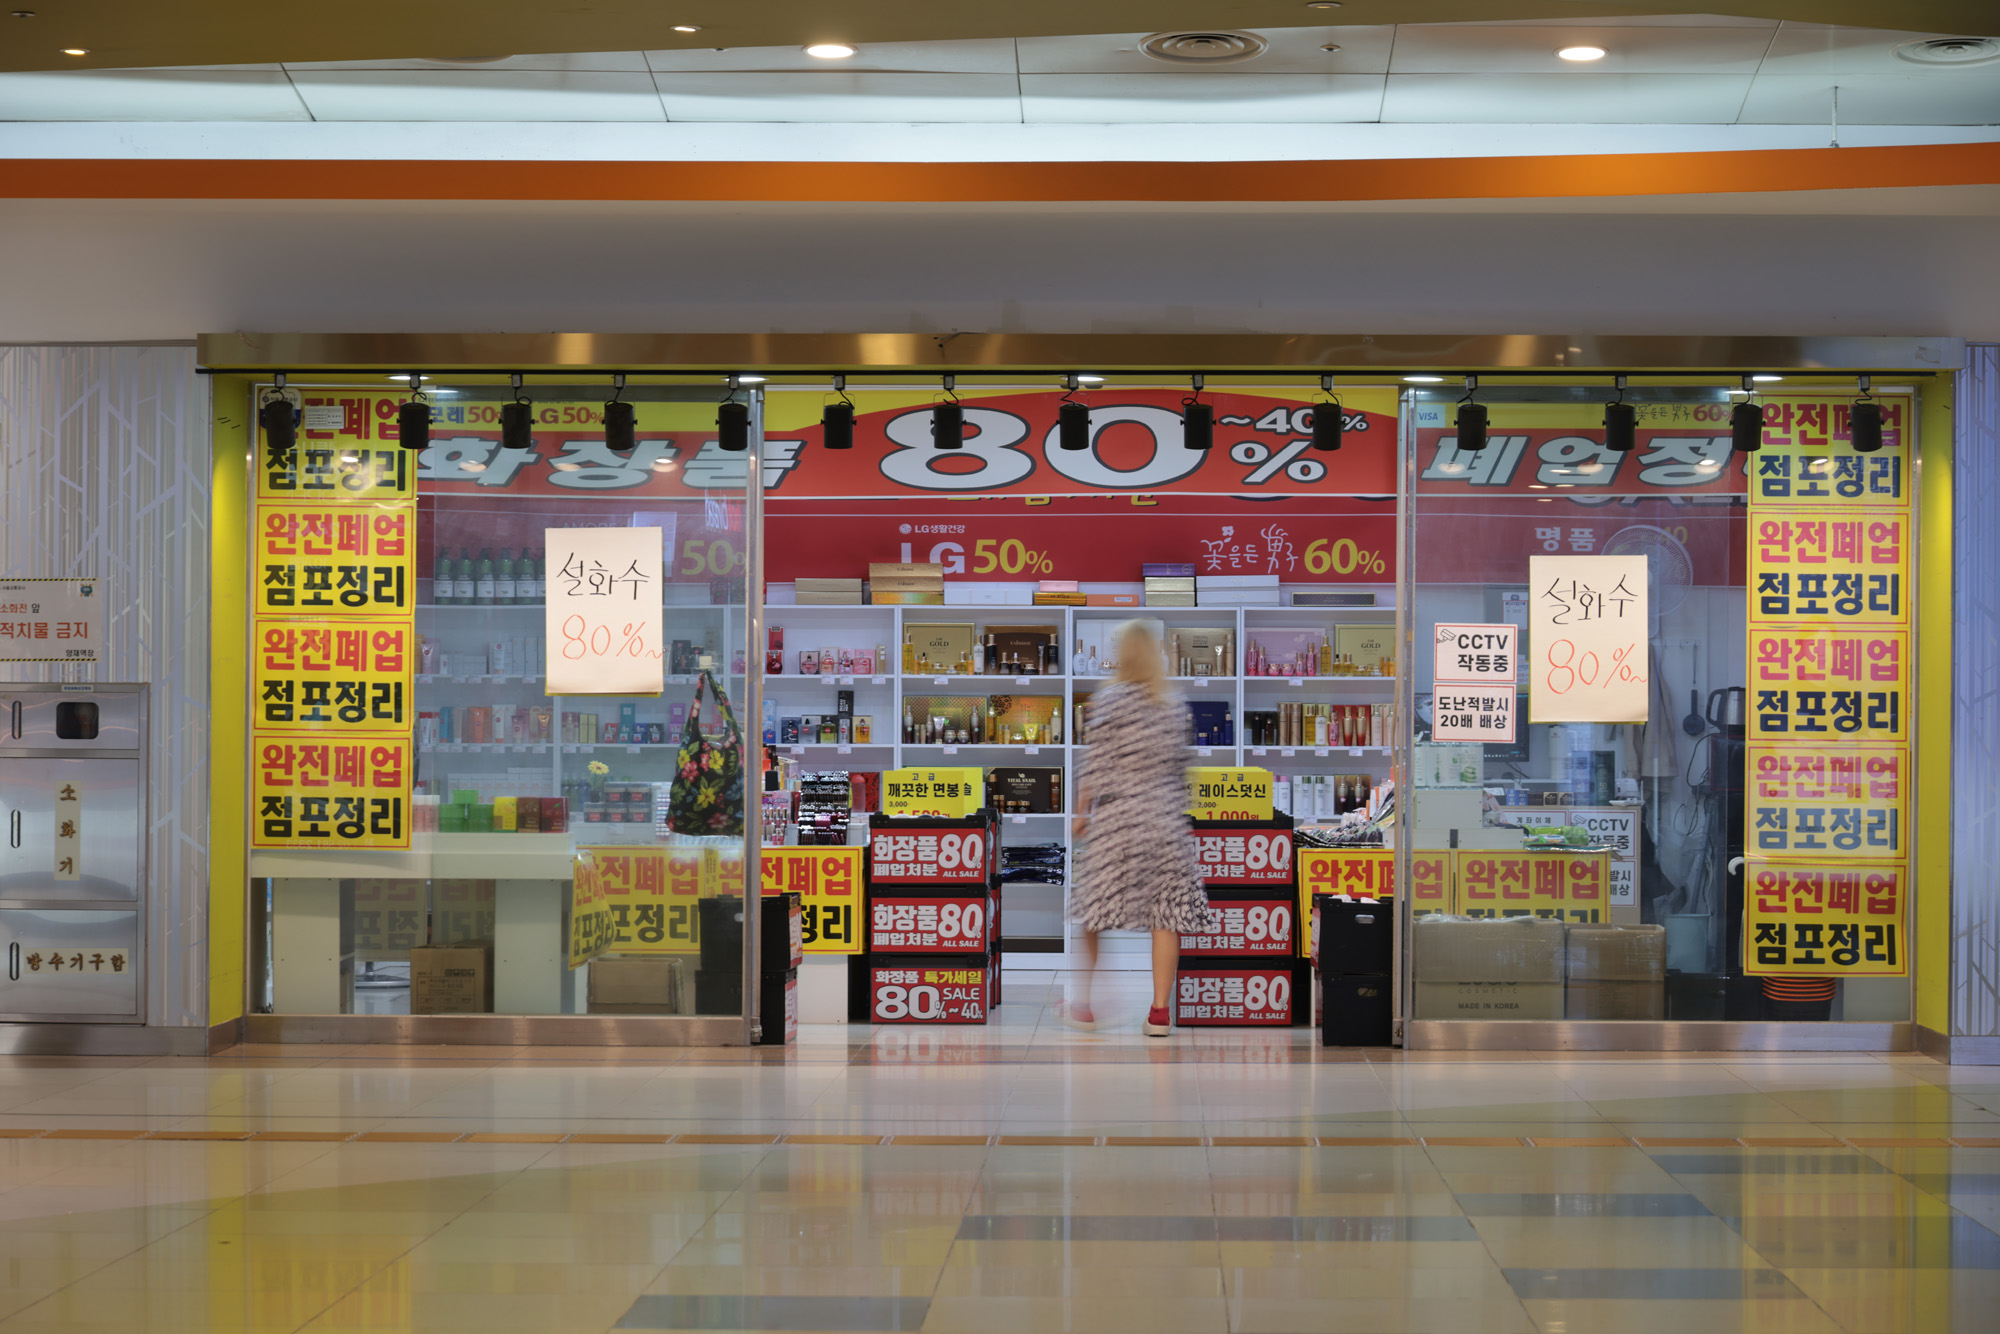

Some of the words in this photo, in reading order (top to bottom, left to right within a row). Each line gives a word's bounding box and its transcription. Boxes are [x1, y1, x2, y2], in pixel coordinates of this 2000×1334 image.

[1418, 411, 1439, 421] VISA
[266, 449, 406, 491] 점포정리
[1420, 436, 1748, 487] 폐업정
[1759, 455, 1901, 498] 점포정리
[265, 513, 405, 556] 완전폐업
[1535, 527, 1596, 552] 명품
[1758, 521, 1900, 564] 완전폐업
[973, 538, 1053, 575] 50%
[1304, 538, 1386, 575] 60%
[264, 565, 404, 607] 점포정리
[557, 552, 650, 600] 설화수
[0, 603, 28, 614] 소화전
[1541, 574, 1639, 624] 설화수
[1758, 573, 1900, 616] 점포정리
[0, 622, 49, 639] 적치물
[56, 622, 89, 639] 금지
[929, 640, 949, 650] GOLD
[1457, 634, 1508, 650] CCTV
[263, 629, 403, 672] 완전폐업
[1360, 643, 1381, 652] GOLD
[1457, 654, 1509, 672] 작동중
[1757, 638, 1899, 681] 완전폐업
[262, 680, 402, 723] 점포정리
[1438, 697, 1509, 711] 도난적발시
[1757, 691, 1898, 733] 점포정리
[1440, 714, 1473, 729] 20배
[1480, 714, 1508, 729] 배상
[261, 744, 402, 787] 완전폐업
[1756, 755, 1898, 798] 완전폐업
[888, 783, 928, 797] 깨끗한
[933, 783, 959, 797] 면봉
[1199, 784, 1266, 798] 레이스덧신
[59, 784, 77, 875] 소화기
[261, 796, 401, 839] 점포정리
[1588, 819, 1629, 831] CCTV
[1756, 808, 1898, 850] 점포정리
[873, 835, 939, 862] 화장품
[873, 863, 939, 877] 폐업처분
[1197, 865, 1246, 878] 업처분
[1465, 860, 1600, 899] 완전폐업
[1755, 871, 1897, 914] 완전폐업
[873, 903, 938, 931] 화장품
[873, 932, 938, 946] 폐업처분
[1180, 936, 1246, 949] 폐업처분
[1755, 923, 1896, 965] 점포정리
[26, 953, 126, 971] 방수기구함
[875, 970, 920, 984] 화장품
[924, 970, 982, 984] 특가세일
[875, 985, 947, 1020] 80%
[943, 987, 980, 1000] SALE
[1179, 976, 1245, 1003] 화장품
[1179, 1005, 1245, 1018] 폐업처분
